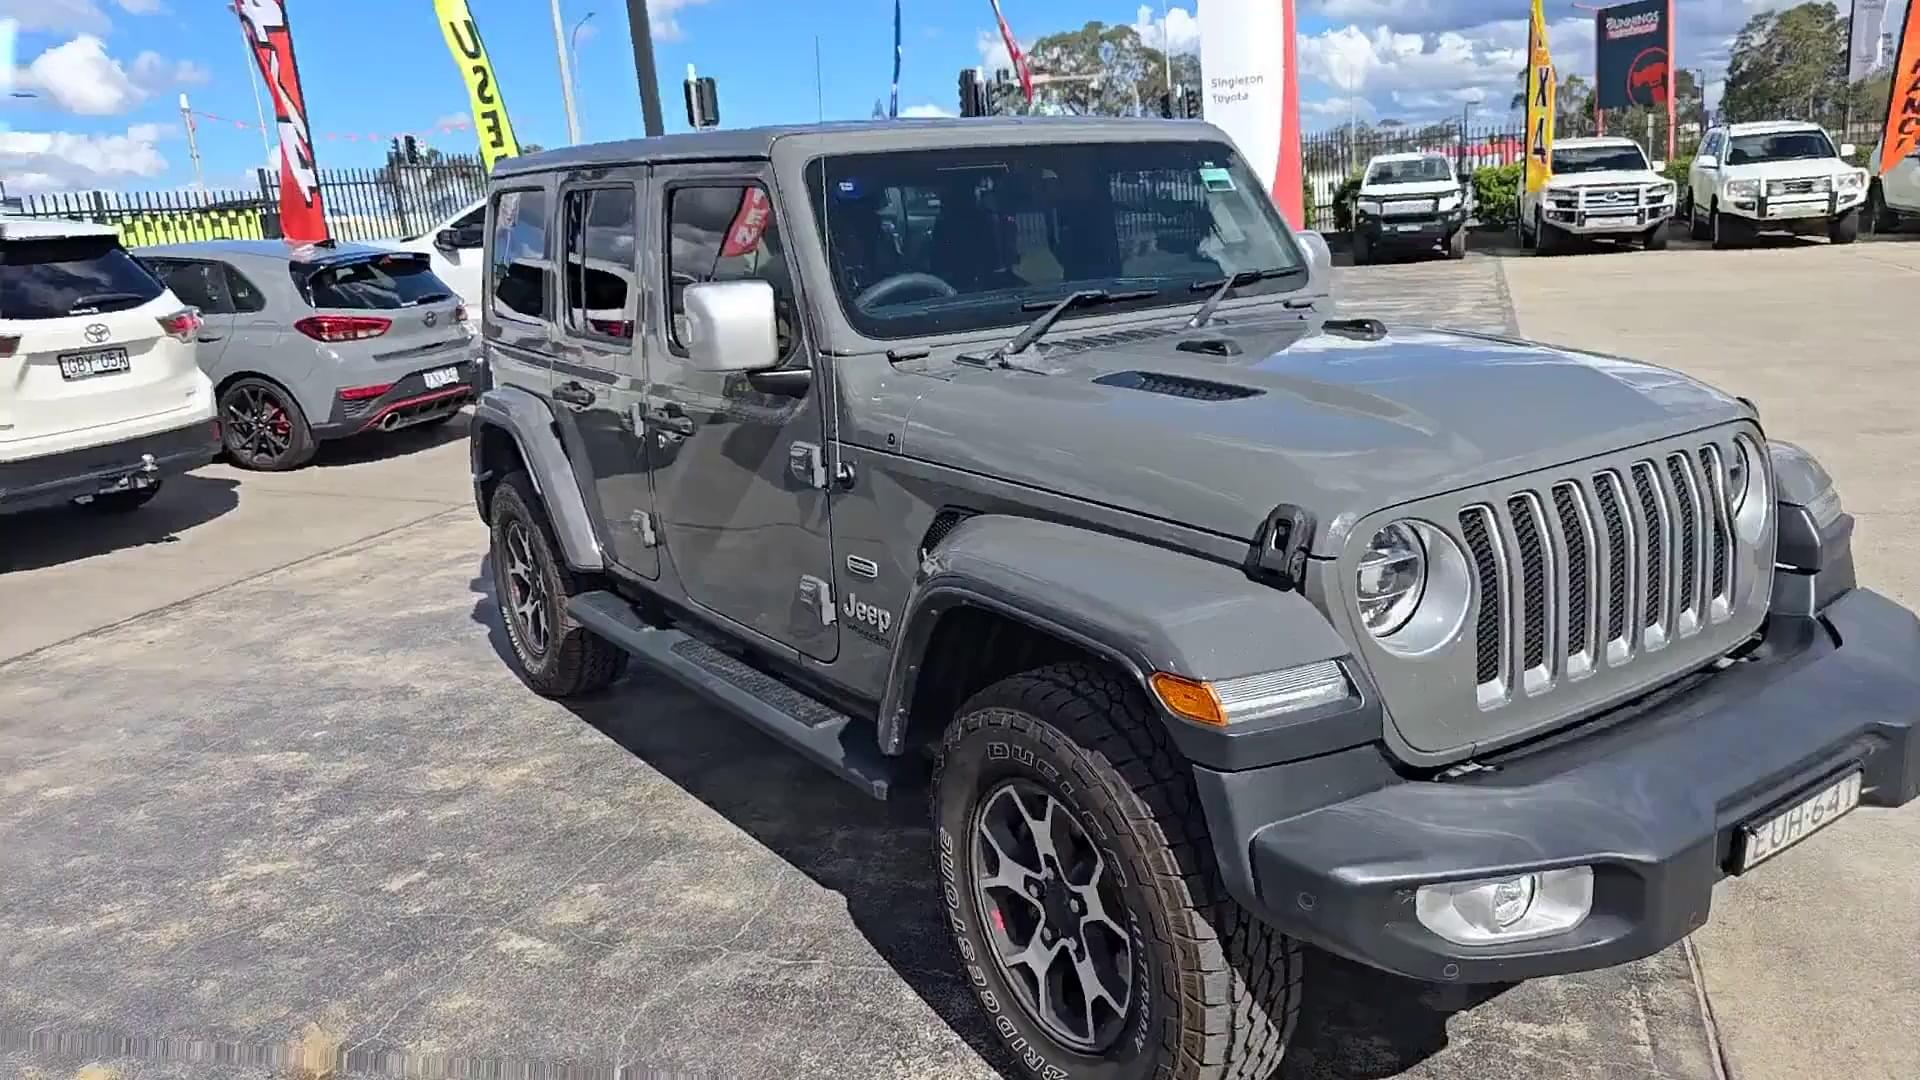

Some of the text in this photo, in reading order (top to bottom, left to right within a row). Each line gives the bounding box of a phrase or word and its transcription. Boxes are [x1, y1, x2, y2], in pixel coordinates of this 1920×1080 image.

[1211, 75, 1264, 90] Singleton
[1212, 92, 1249, 104] Toyota
[843, 592, 891, 633] Jeep
[939, 826, 1069, 1080] BRIDGESTONE
